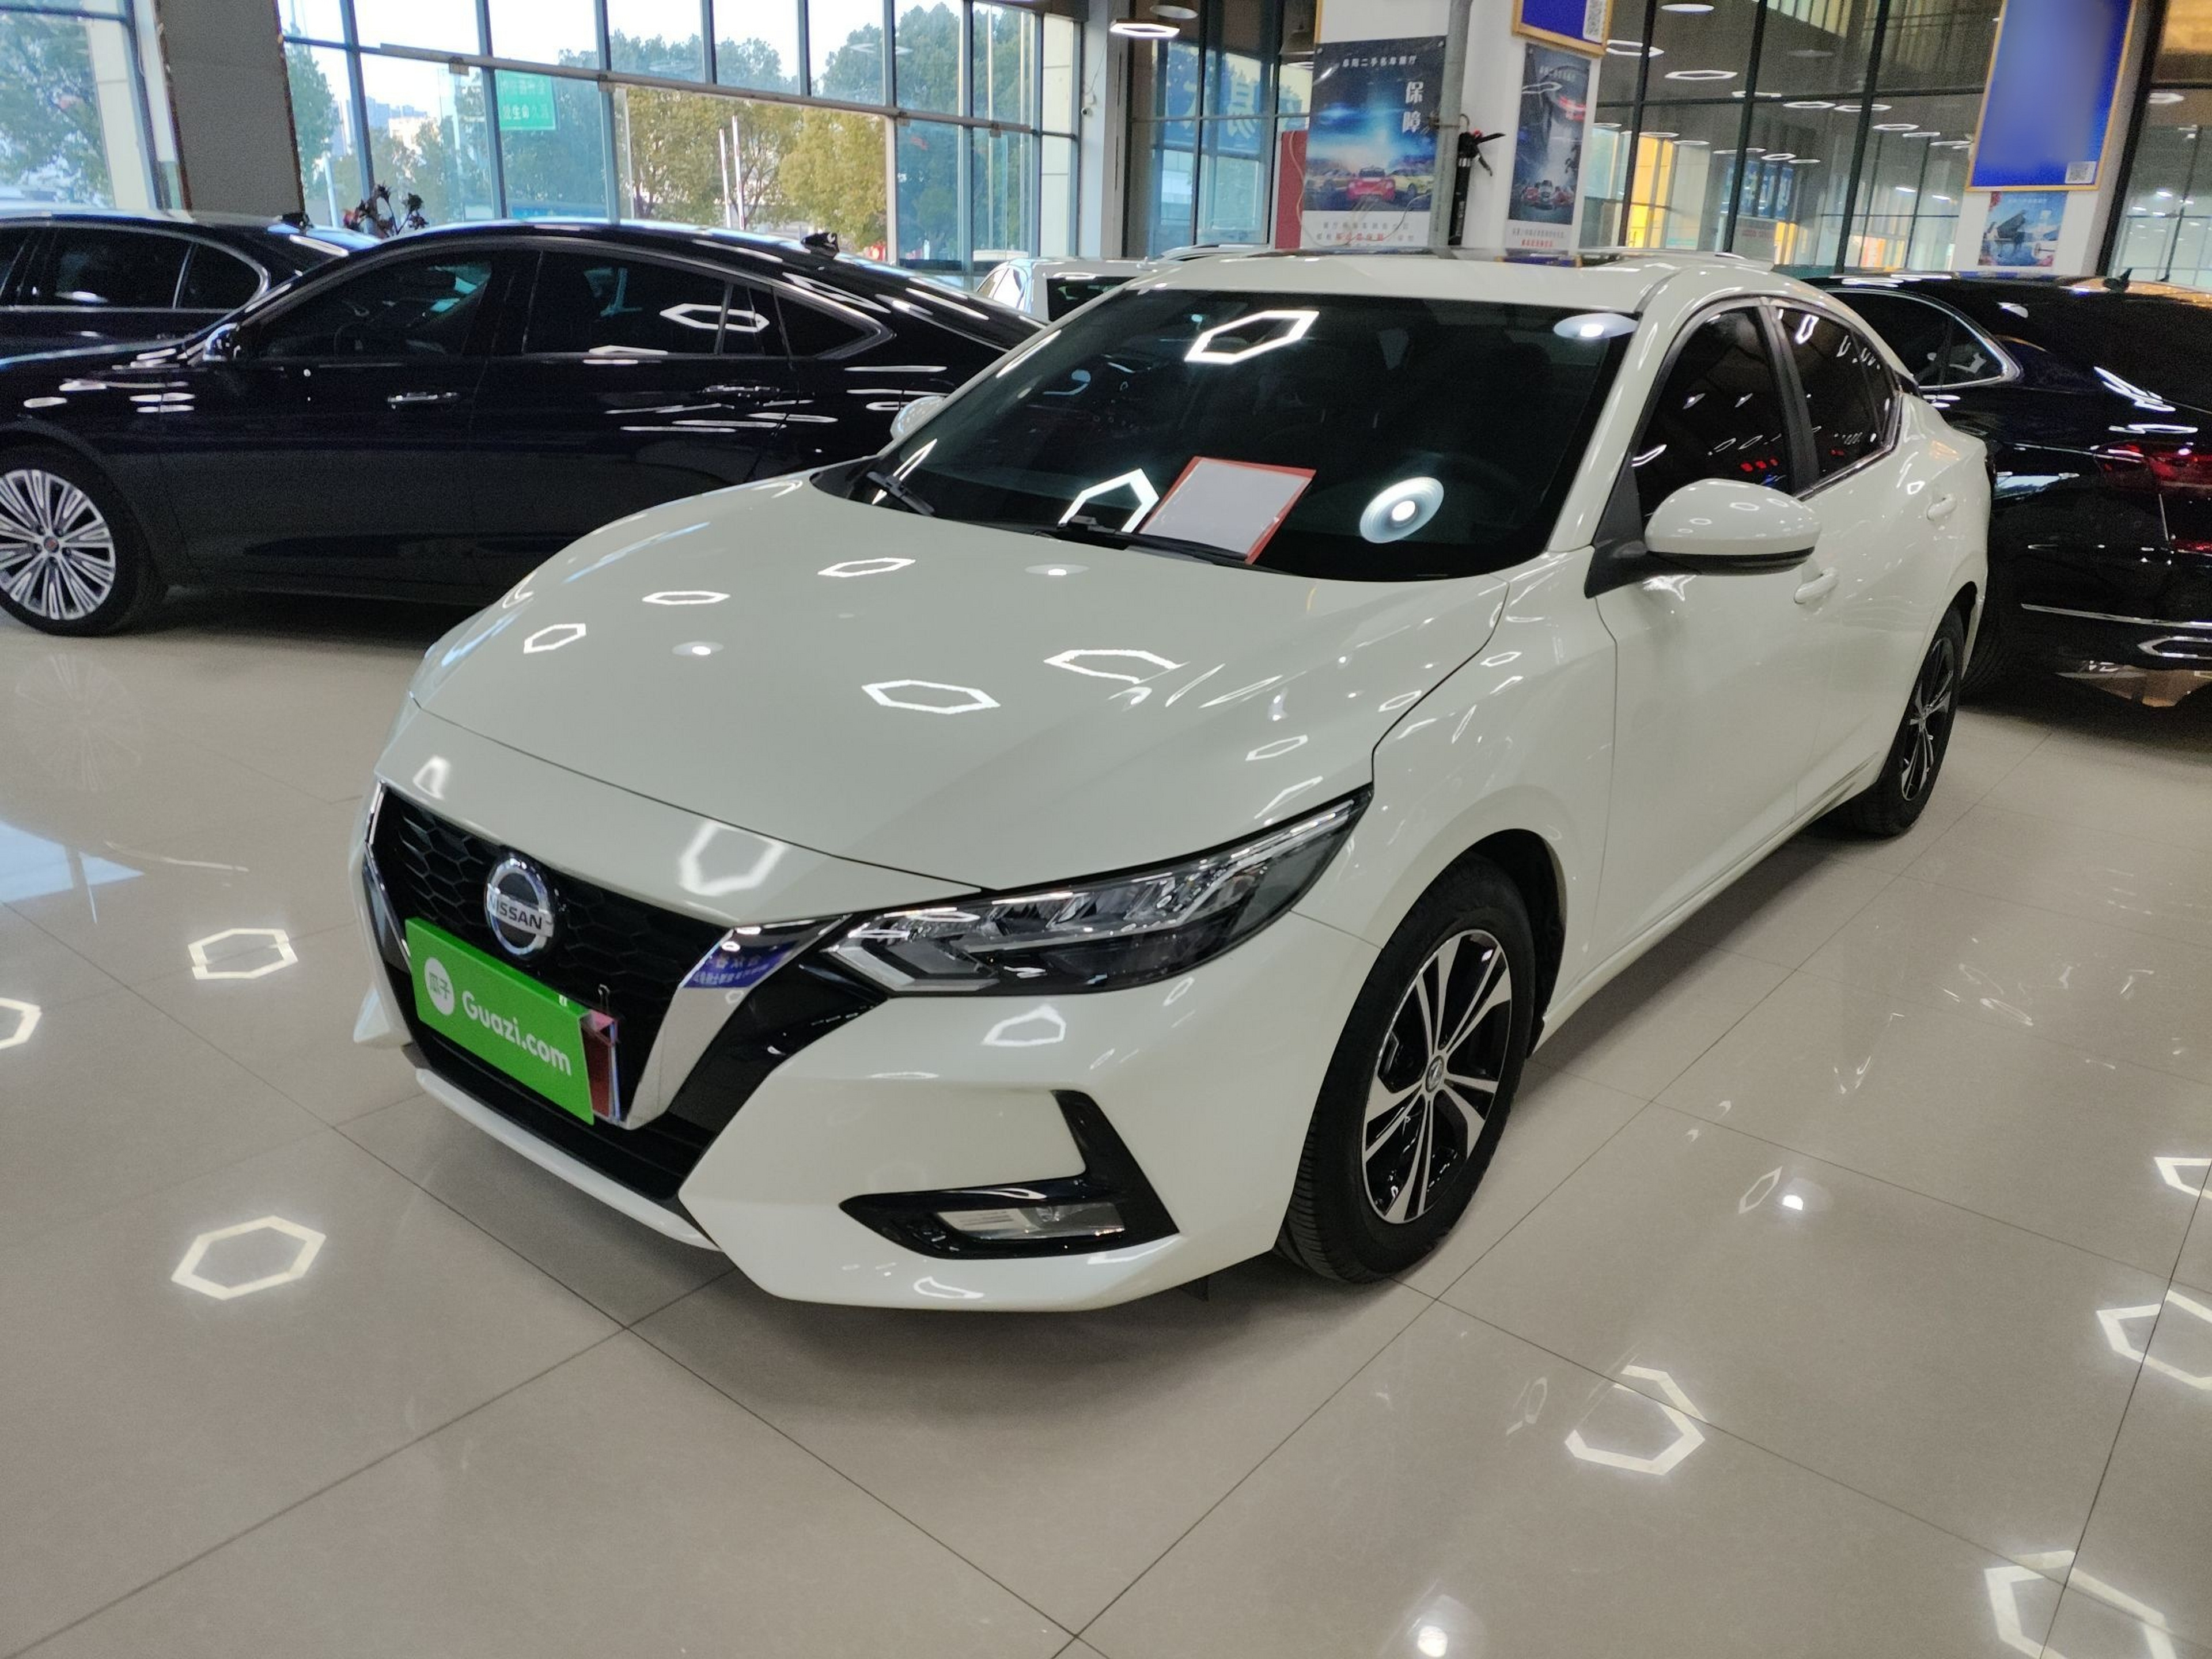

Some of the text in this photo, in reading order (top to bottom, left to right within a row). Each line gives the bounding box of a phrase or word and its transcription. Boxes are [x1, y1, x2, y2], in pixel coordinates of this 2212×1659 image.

[488, 893, 541, 930] NISSAN
[429, 971, 450, 999] 瓜子
[462, 990, 571, 1076] Guazi.com
